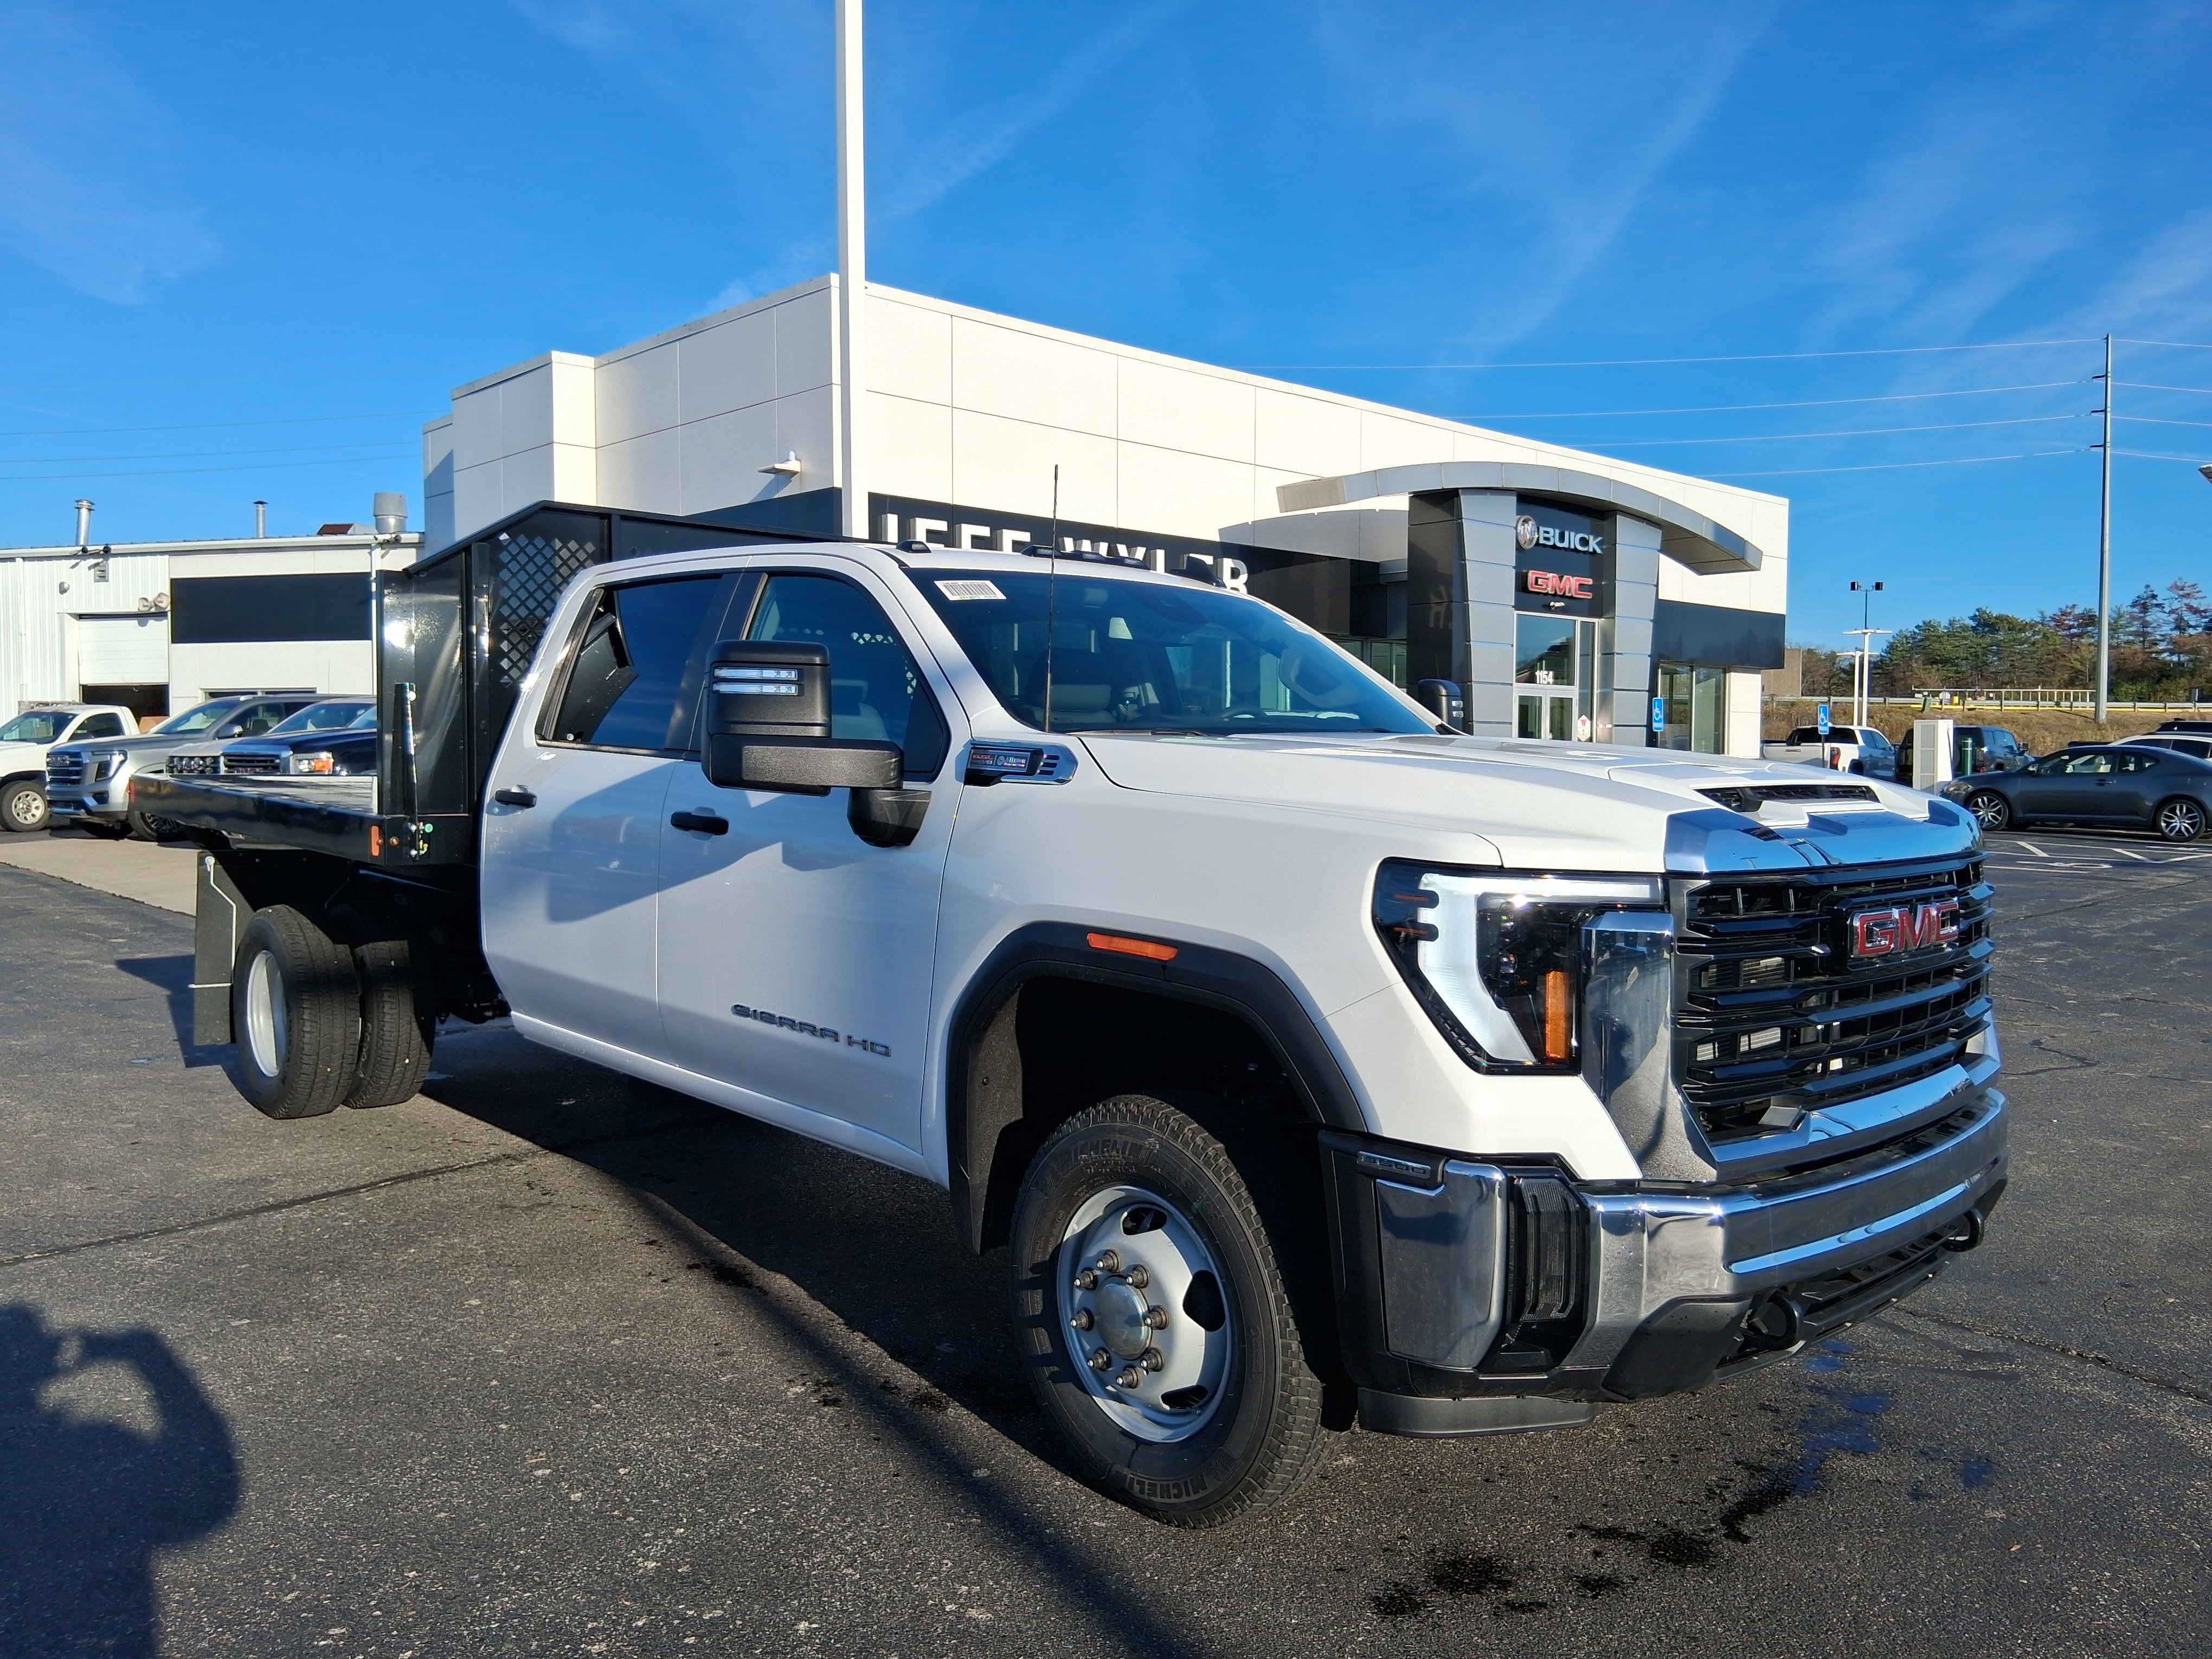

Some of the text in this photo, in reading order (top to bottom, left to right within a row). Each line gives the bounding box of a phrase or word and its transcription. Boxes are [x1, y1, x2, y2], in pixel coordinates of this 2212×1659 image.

[1539, 525, 1603, 554] BUICK
[1528, 570, 1593, 599] GMC
[1535, 670, 1553, 684] 1154
[1853, 901, 1959, 957] GMC
[730, 1004, 891, 1057] SIERRA HD
